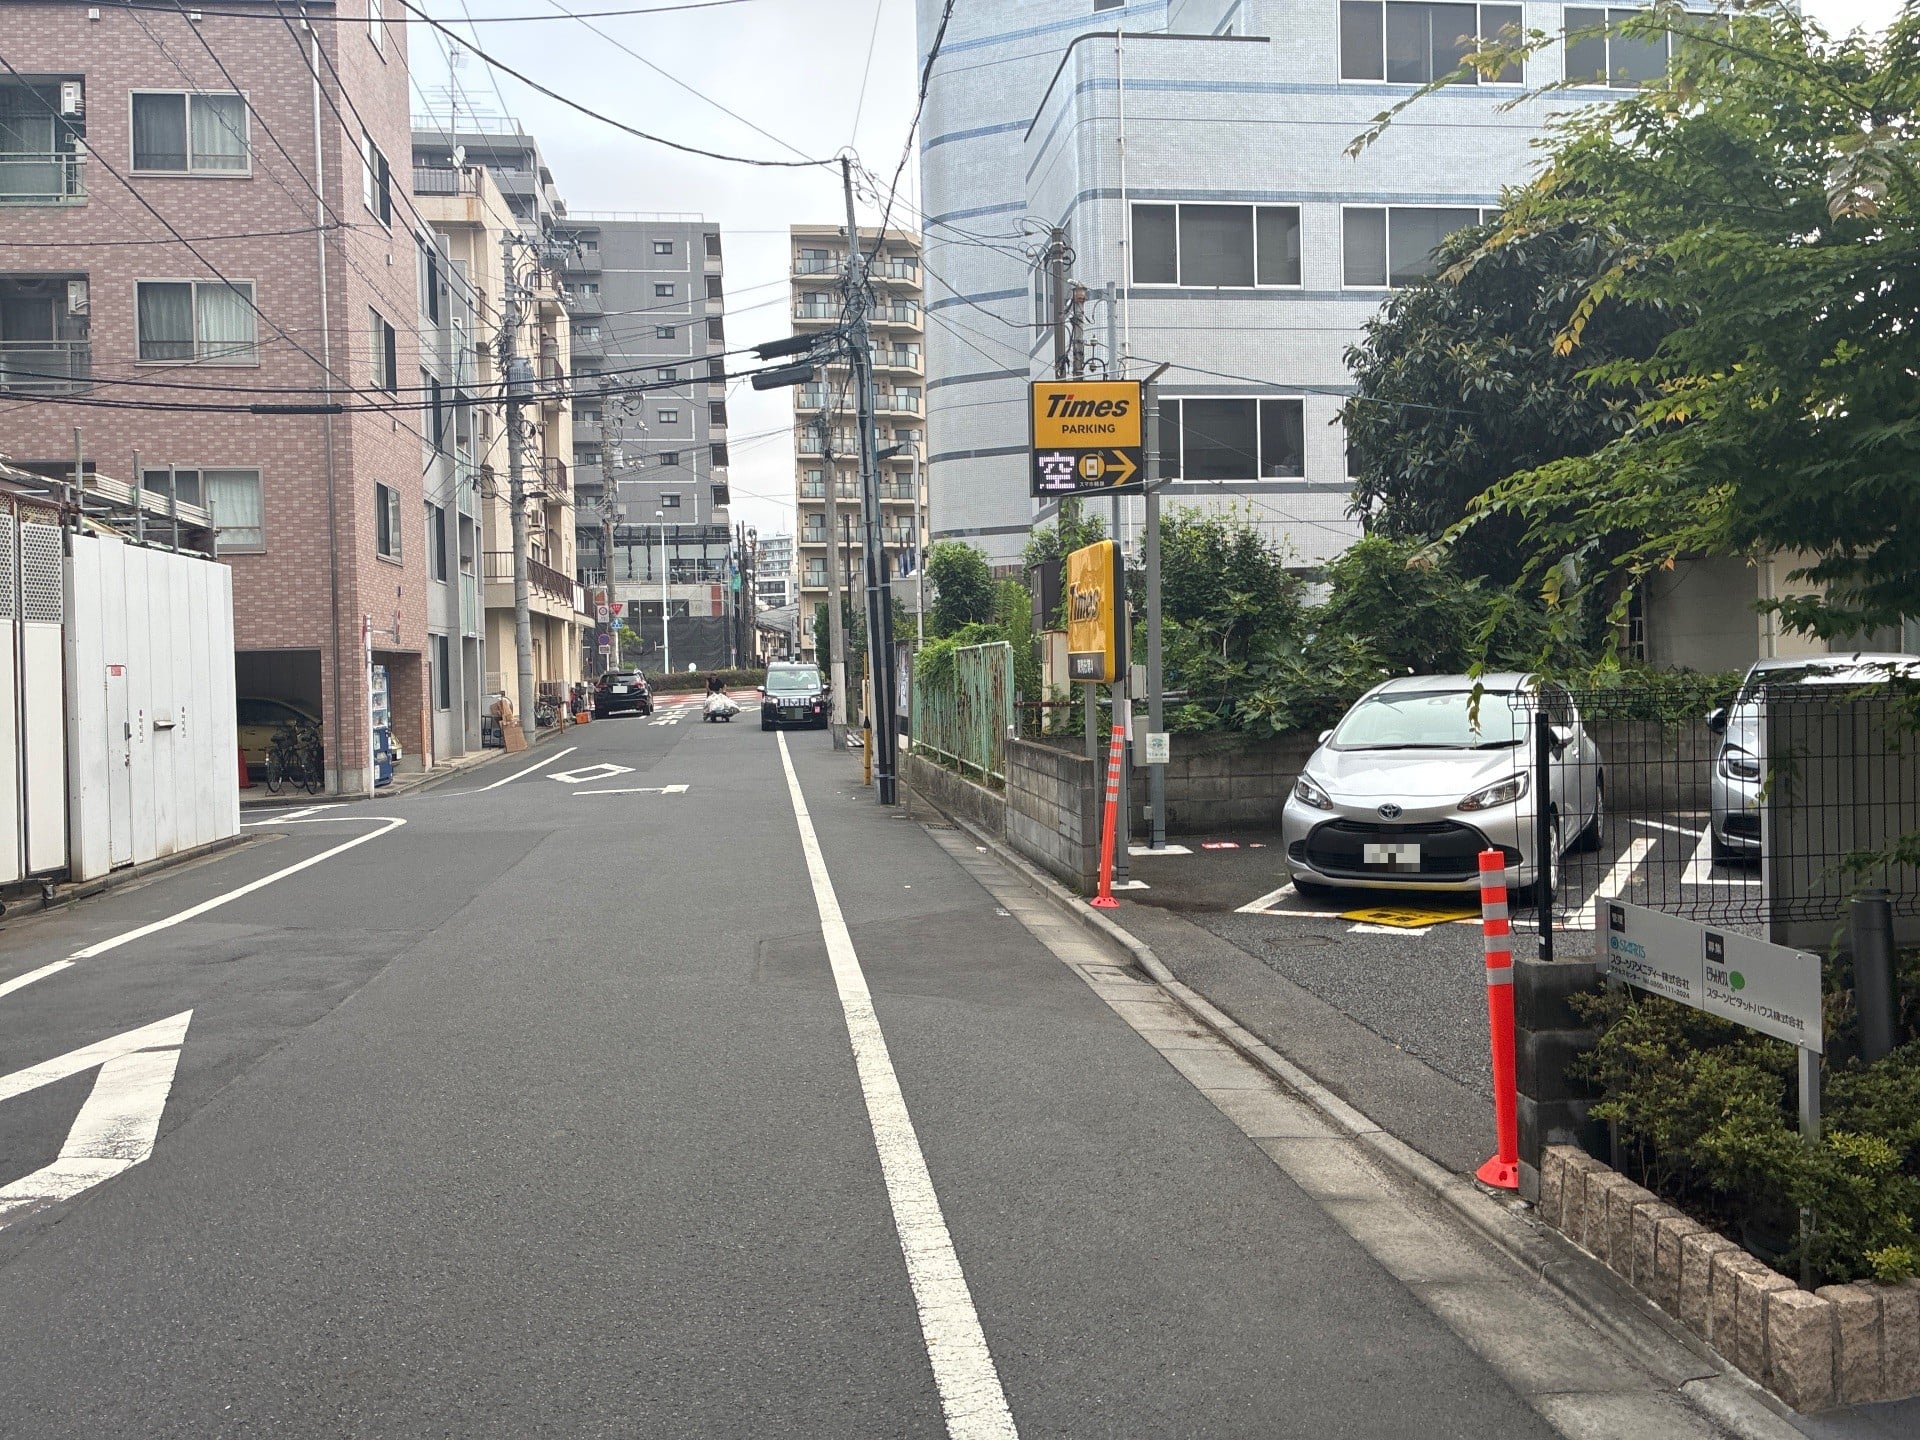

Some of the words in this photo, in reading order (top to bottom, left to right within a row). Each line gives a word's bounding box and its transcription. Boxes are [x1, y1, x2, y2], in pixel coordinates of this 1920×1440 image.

[1047, 394, 1130, 418] Times
[1062, 424, 1116, 434] PARKING
[1039, 452, 1076, 490] 空
[1070, 584, 1100, 621] Times
[1706, 987, 1805, 1031] スターツピタットハウス株式会社
